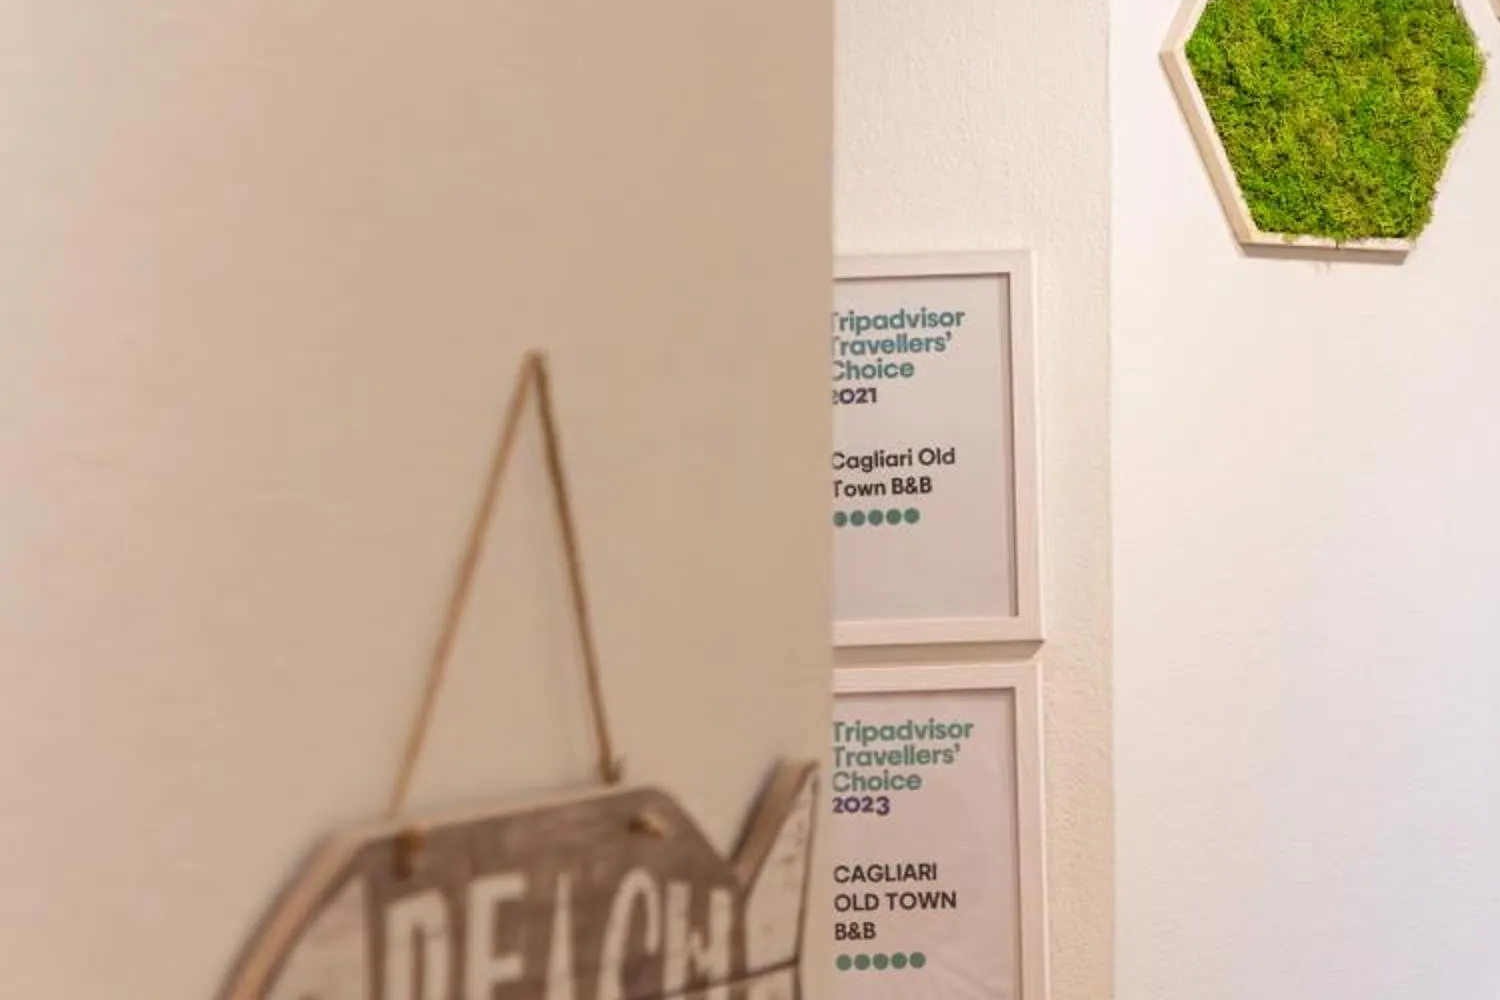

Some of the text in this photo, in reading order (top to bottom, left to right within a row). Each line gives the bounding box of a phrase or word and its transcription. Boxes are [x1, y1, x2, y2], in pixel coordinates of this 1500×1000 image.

[832, 448, 955, 473] Cagliari Old
[833, 476, 932, 498] Town B&B
[832, 718, 974, 746] Tripadvisor
[832, 769, 922, 792] Choice
[832, 796, 891, 816] 2023
[833, 862, 937, 883] CAGLIARI
[834, 891, 957, 912] OLD TOWN
[834, 922, 876, 940] B&B
